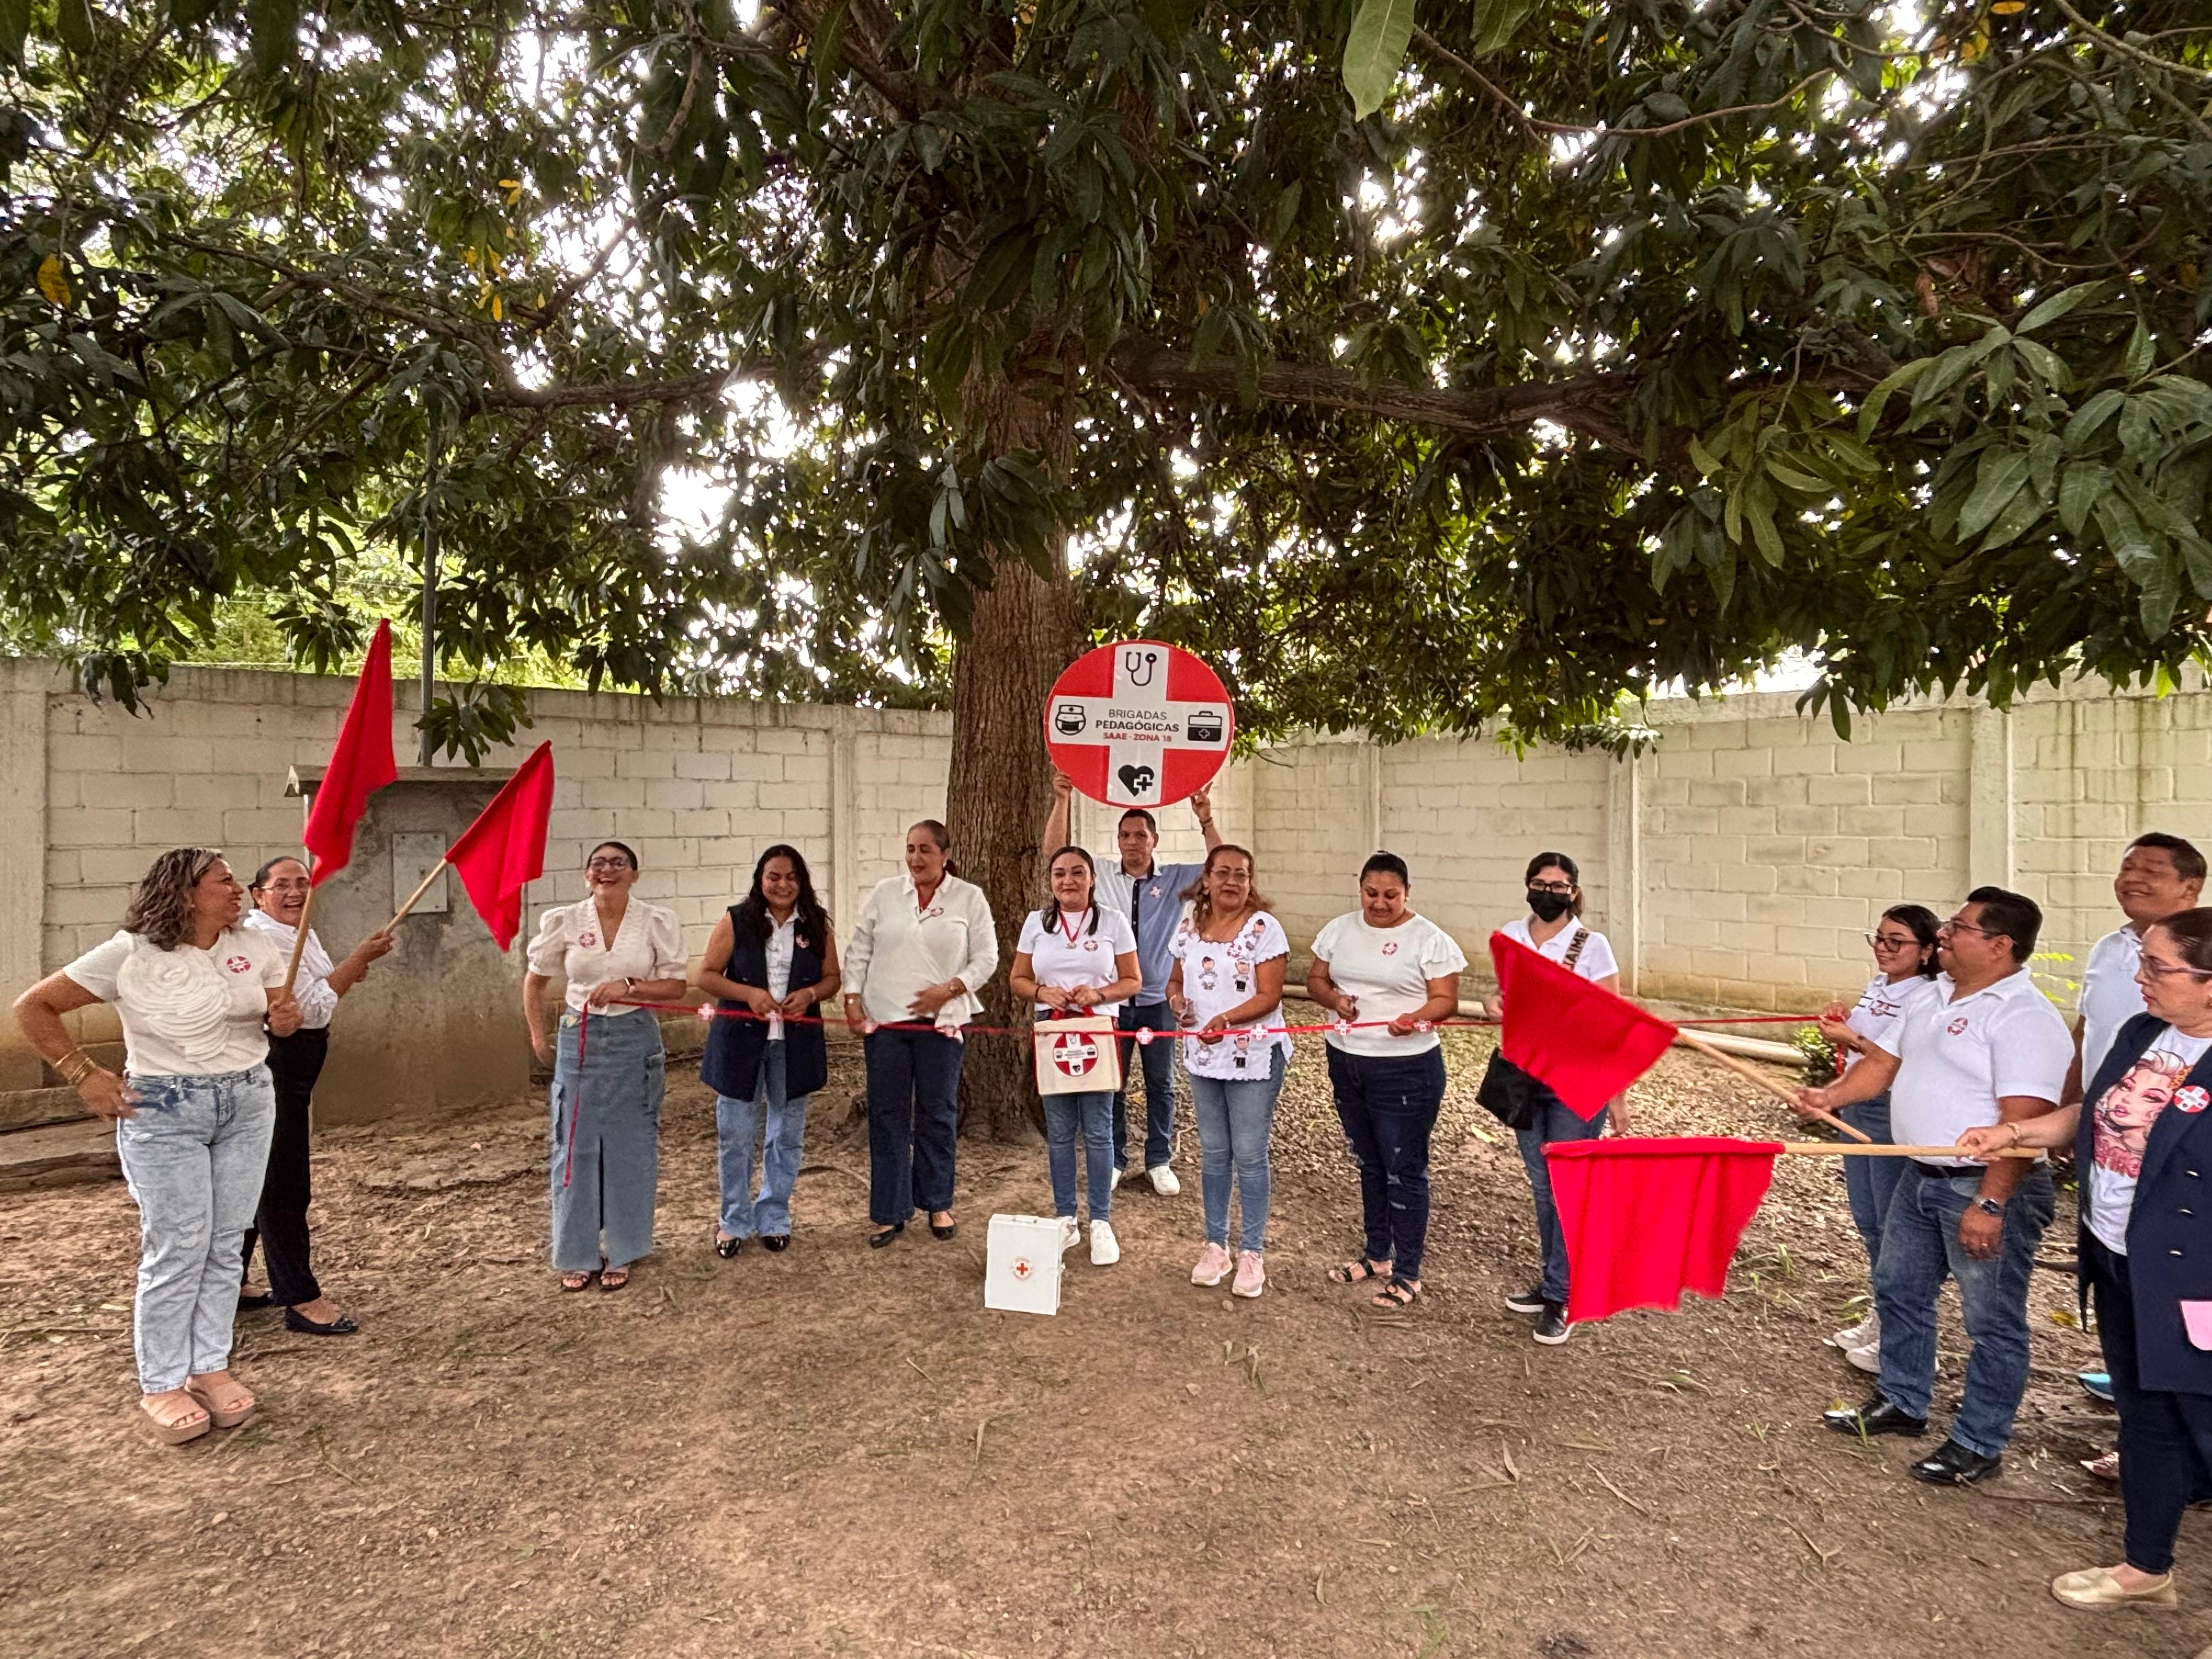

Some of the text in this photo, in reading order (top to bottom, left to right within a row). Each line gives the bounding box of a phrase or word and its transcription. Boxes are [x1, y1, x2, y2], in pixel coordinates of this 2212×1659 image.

[1108, 709, 1167, 720] BRIGADAS
[1095, 720, 1180, 732] PEDAGÓGICAS
[1133, 733, 1160, 742] ZONA
